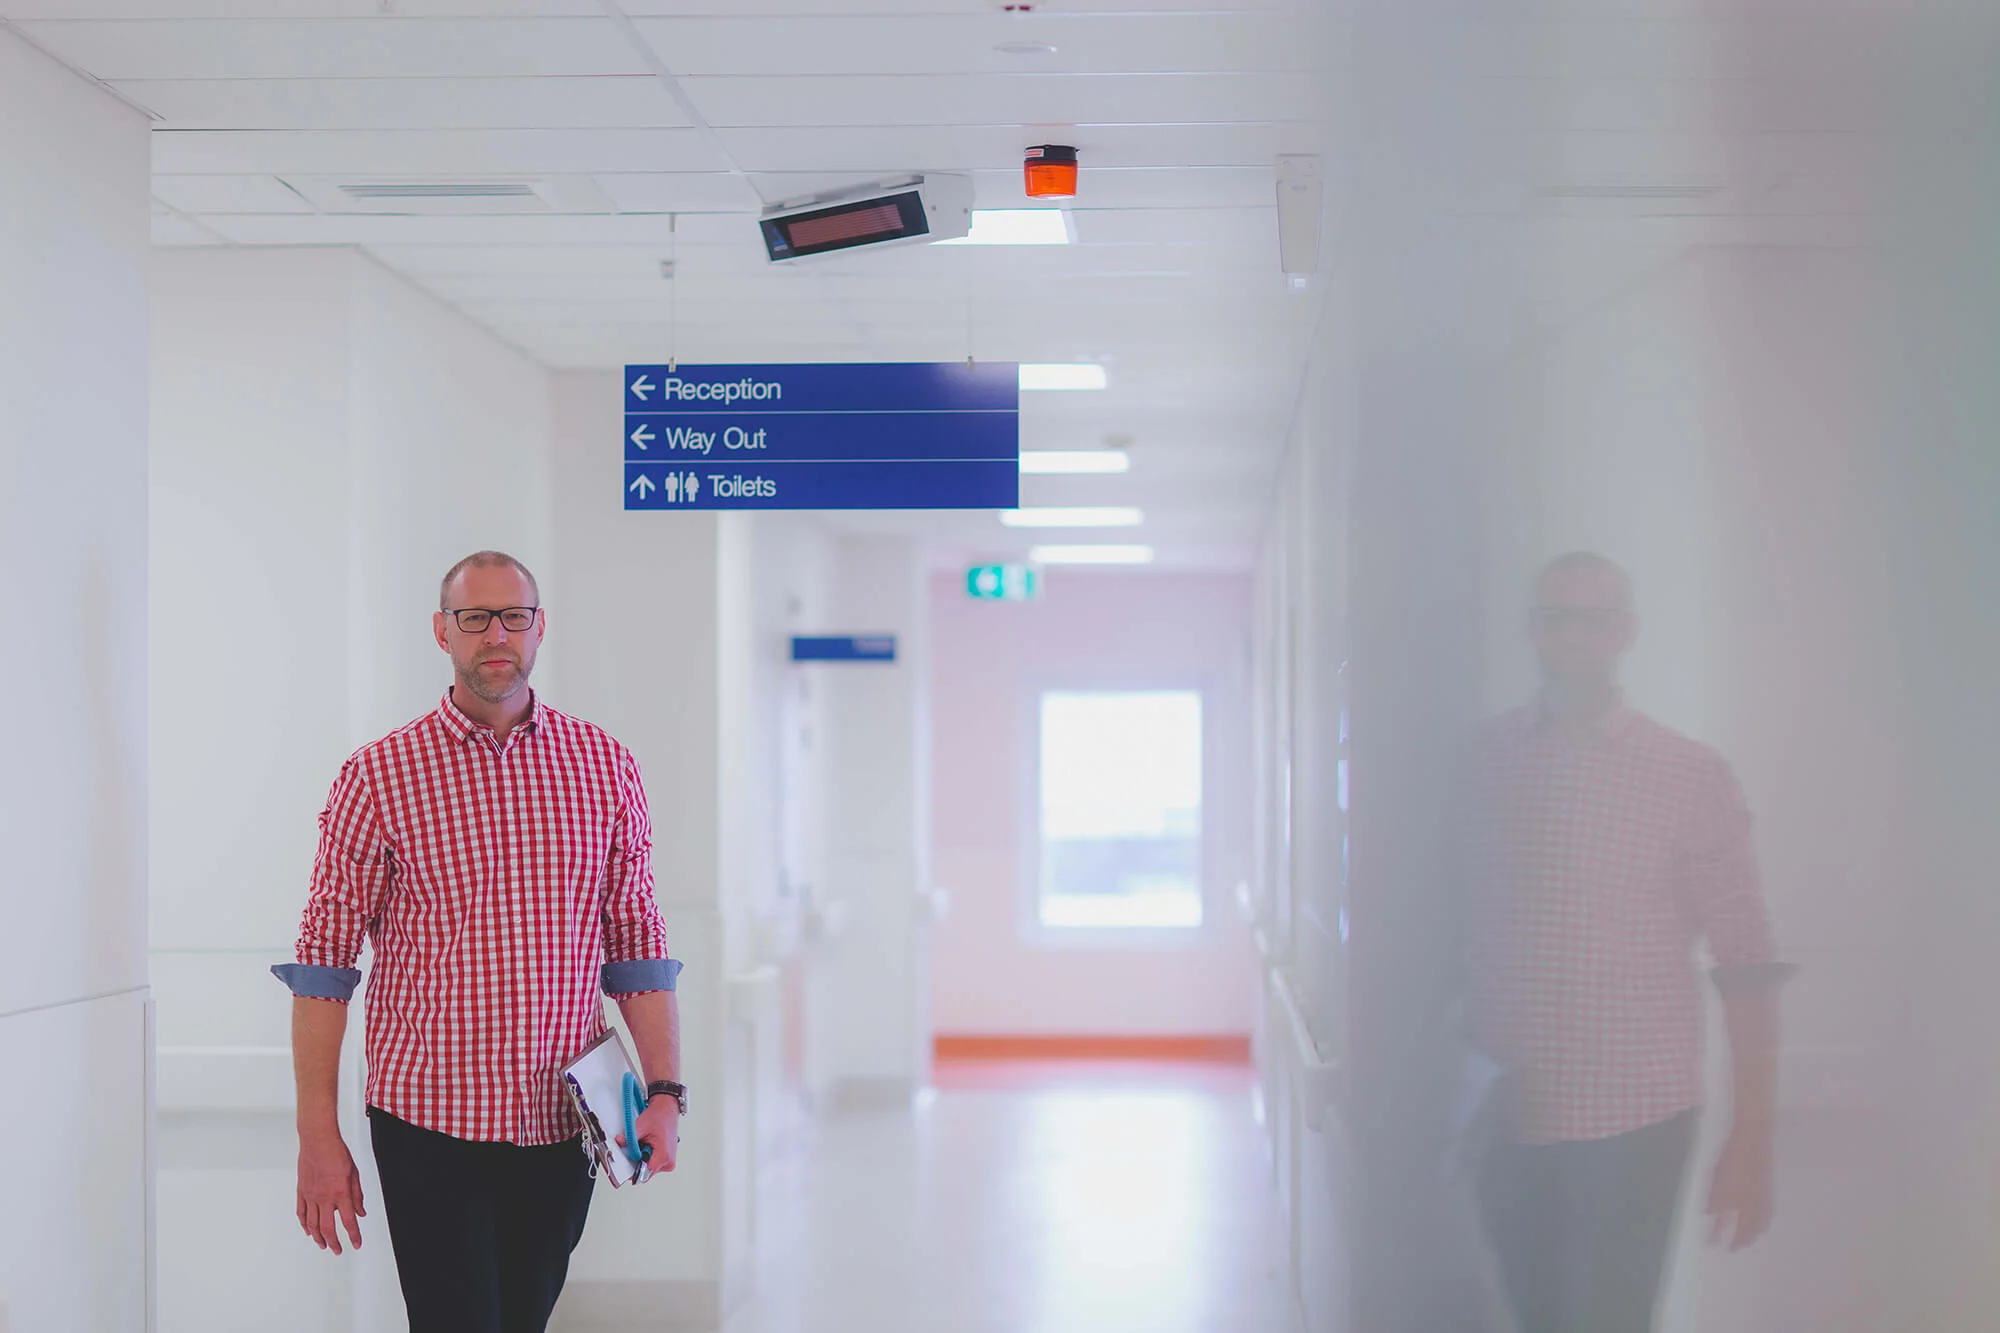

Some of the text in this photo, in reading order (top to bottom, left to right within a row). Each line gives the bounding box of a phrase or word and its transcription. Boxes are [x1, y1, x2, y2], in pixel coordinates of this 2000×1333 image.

[665, 378, 782, 405] Reception
[665, 427, 767, 455] Way Out
[708, 475, 777, 497] Toilets
